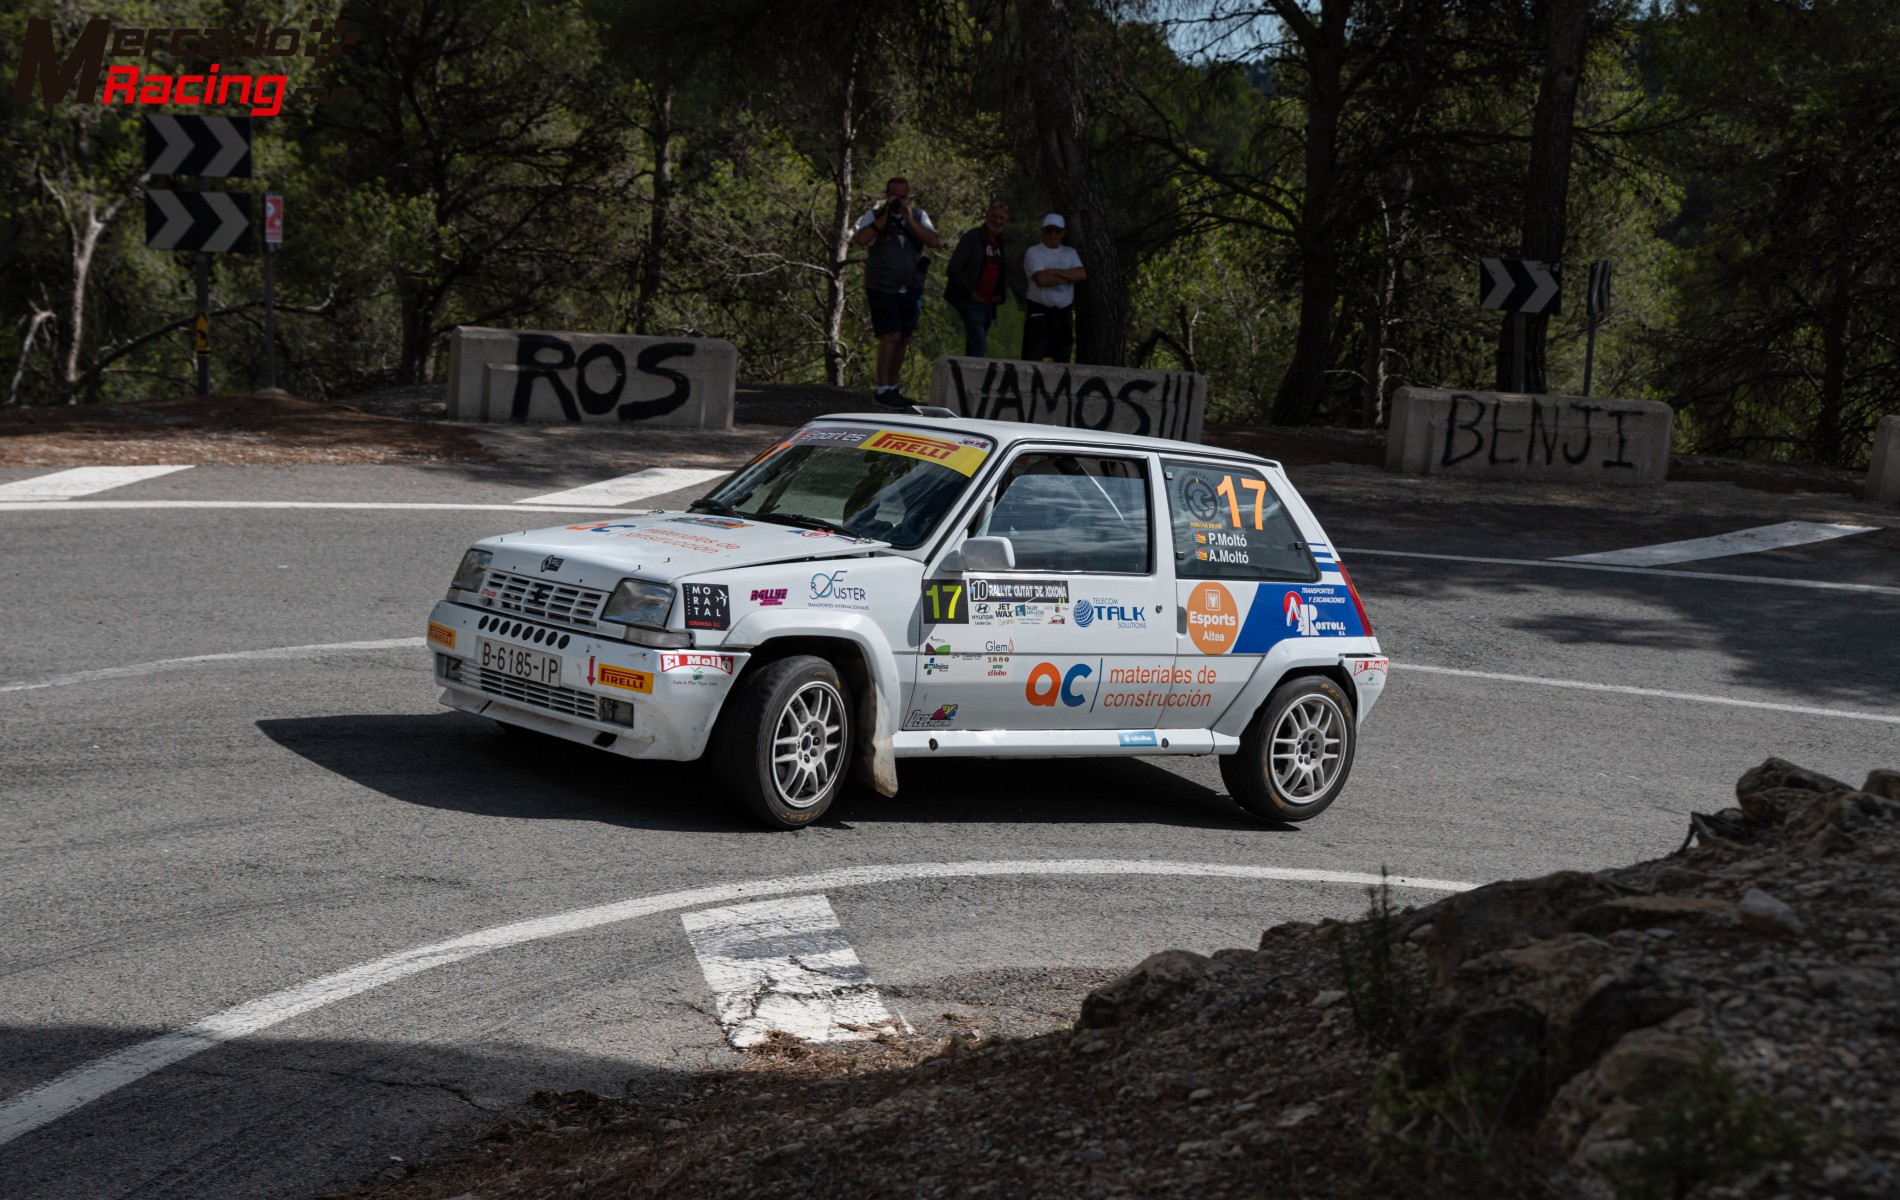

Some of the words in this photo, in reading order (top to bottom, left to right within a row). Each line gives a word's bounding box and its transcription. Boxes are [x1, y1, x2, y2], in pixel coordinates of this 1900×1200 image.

[511, 333, 696, 421] ROS
[1440, 394, 1644, 468] BENJI
[872, 433, 960, 460] PIRELLI
[1216, 475, 1267, 531] 17
[1208, 532, 1247, 547] P.Moltó
[1209, 549, 1249, 564] A.Moltó
[972, 580, 988, 601] 10
[988, 584, 1012, 597] RALLYE
[1034, 585, 1044, 597] DE
[1045, 585, 1067, 597] XIXONA
[925, 584, 962, 619] 17
[1092, 597, 1118, 605] TELECOM
[995, 610, 1013, 618] WAX
[1094, 606, 1145, 621] TALK
[1189, 611, 1236, 628] Esports
[1117, 621, 1147, 629] SOLUTIONS
[429, 624, 453, 646] PIRELLI
[1202, 631, 1225, 642] Altea
[985, 640, 1008, 652] Glem
[482, 641, 558, 683] B-6185-IP
[663, 655, 680, 671] El
[686, 655, 732, 671] Molló
[1355, 661, 1365, 675] El
[600, 667, 645, 689] PIRELLI
[1025, 661, 1093, 708] ac
[1109, 664, 1193, 685] materiales
[1196, 664, 1217, 685] de
[1103, 688, 1212, 708] construcción
